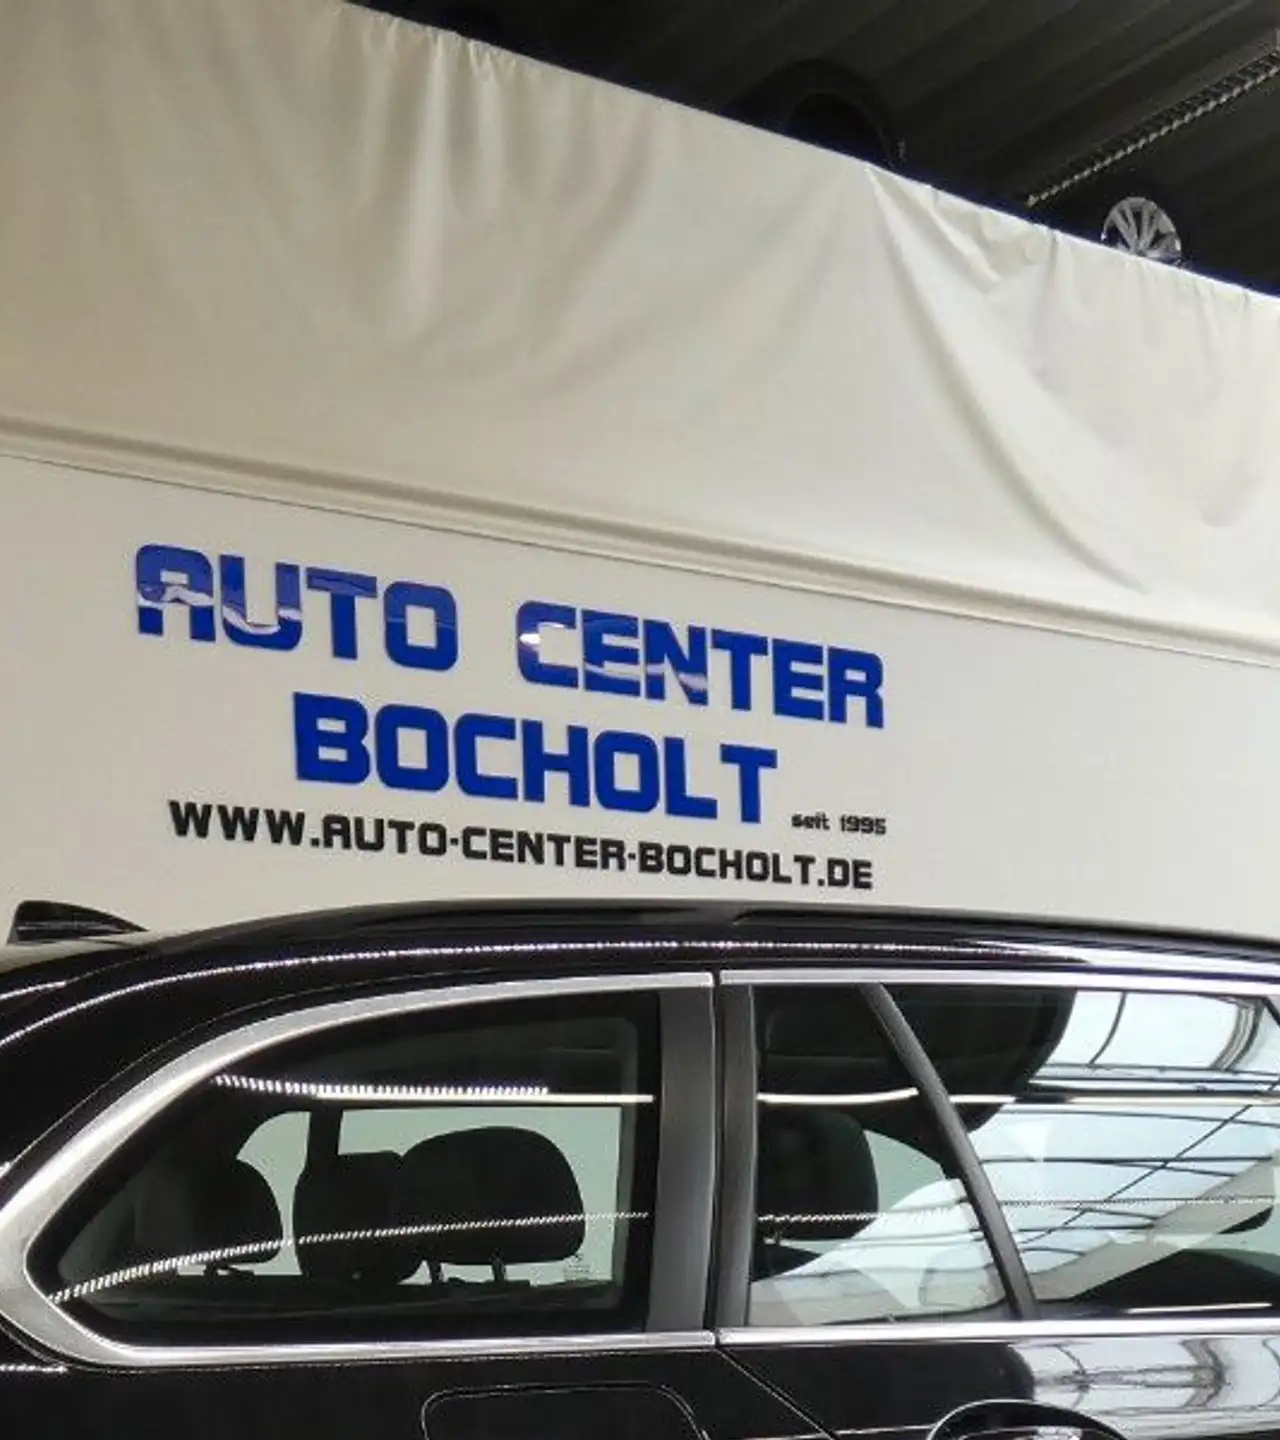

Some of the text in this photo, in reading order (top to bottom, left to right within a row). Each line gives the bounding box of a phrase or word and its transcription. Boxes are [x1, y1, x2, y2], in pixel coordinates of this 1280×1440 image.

[134, 543, 886, 729] AUTO CENTER
[292, 691, 778, 825] BOCHOLT
[791, 811, 887, 836] seit 1995
